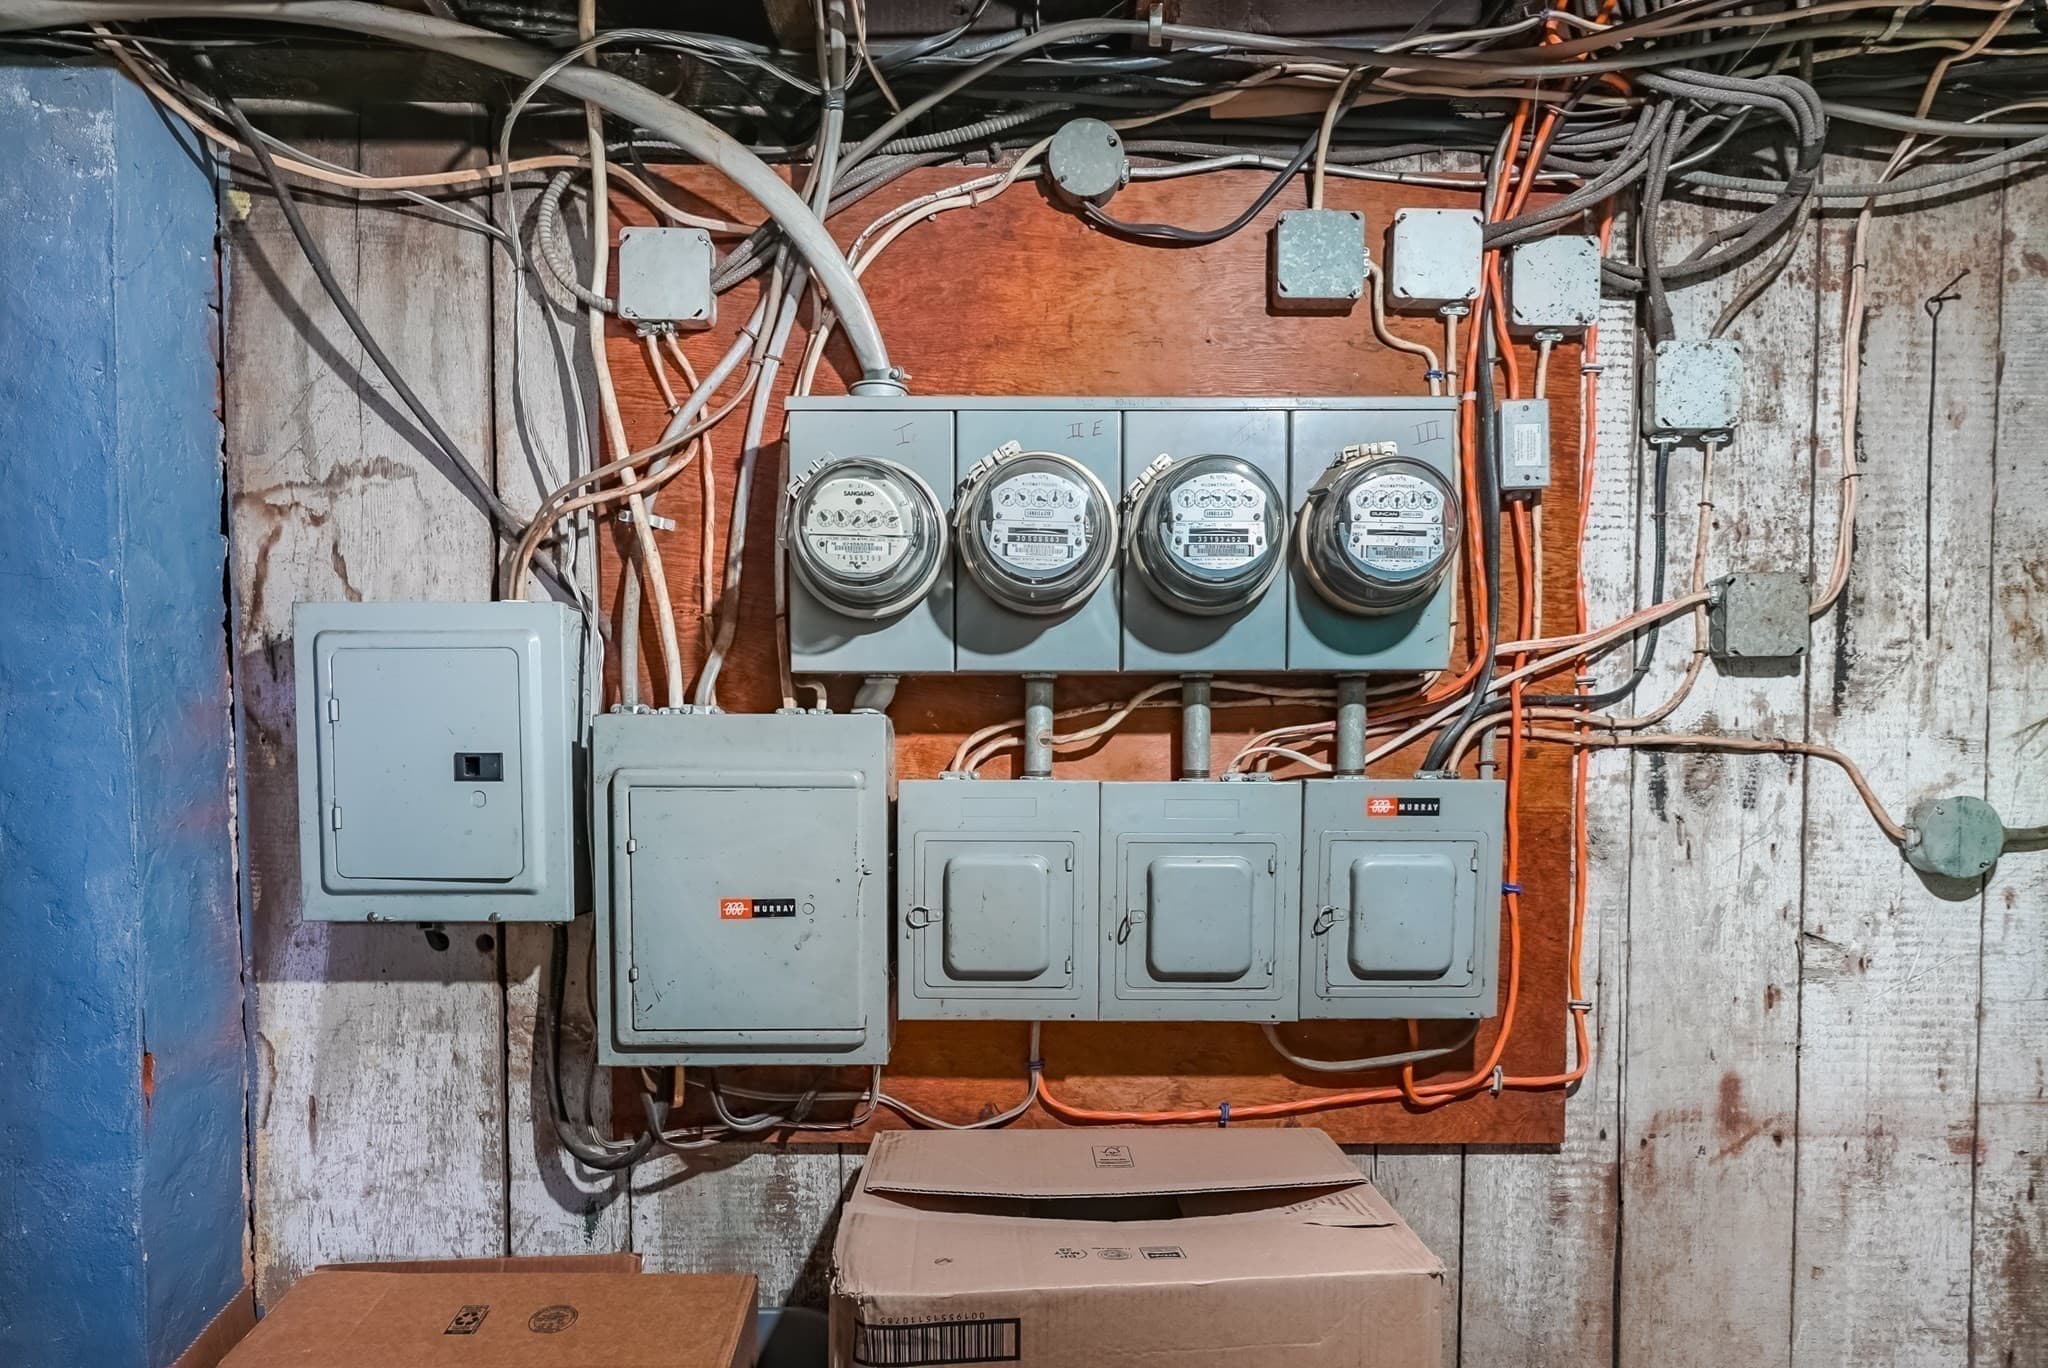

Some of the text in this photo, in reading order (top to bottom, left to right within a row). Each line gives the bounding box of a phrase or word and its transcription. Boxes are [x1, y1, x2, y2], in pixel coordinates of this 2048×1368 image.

[1092, 419, 1103, 437] E
[1398, 803, 1439, 811] MURRAY
[753, 905, 795, 913] MURRAY
